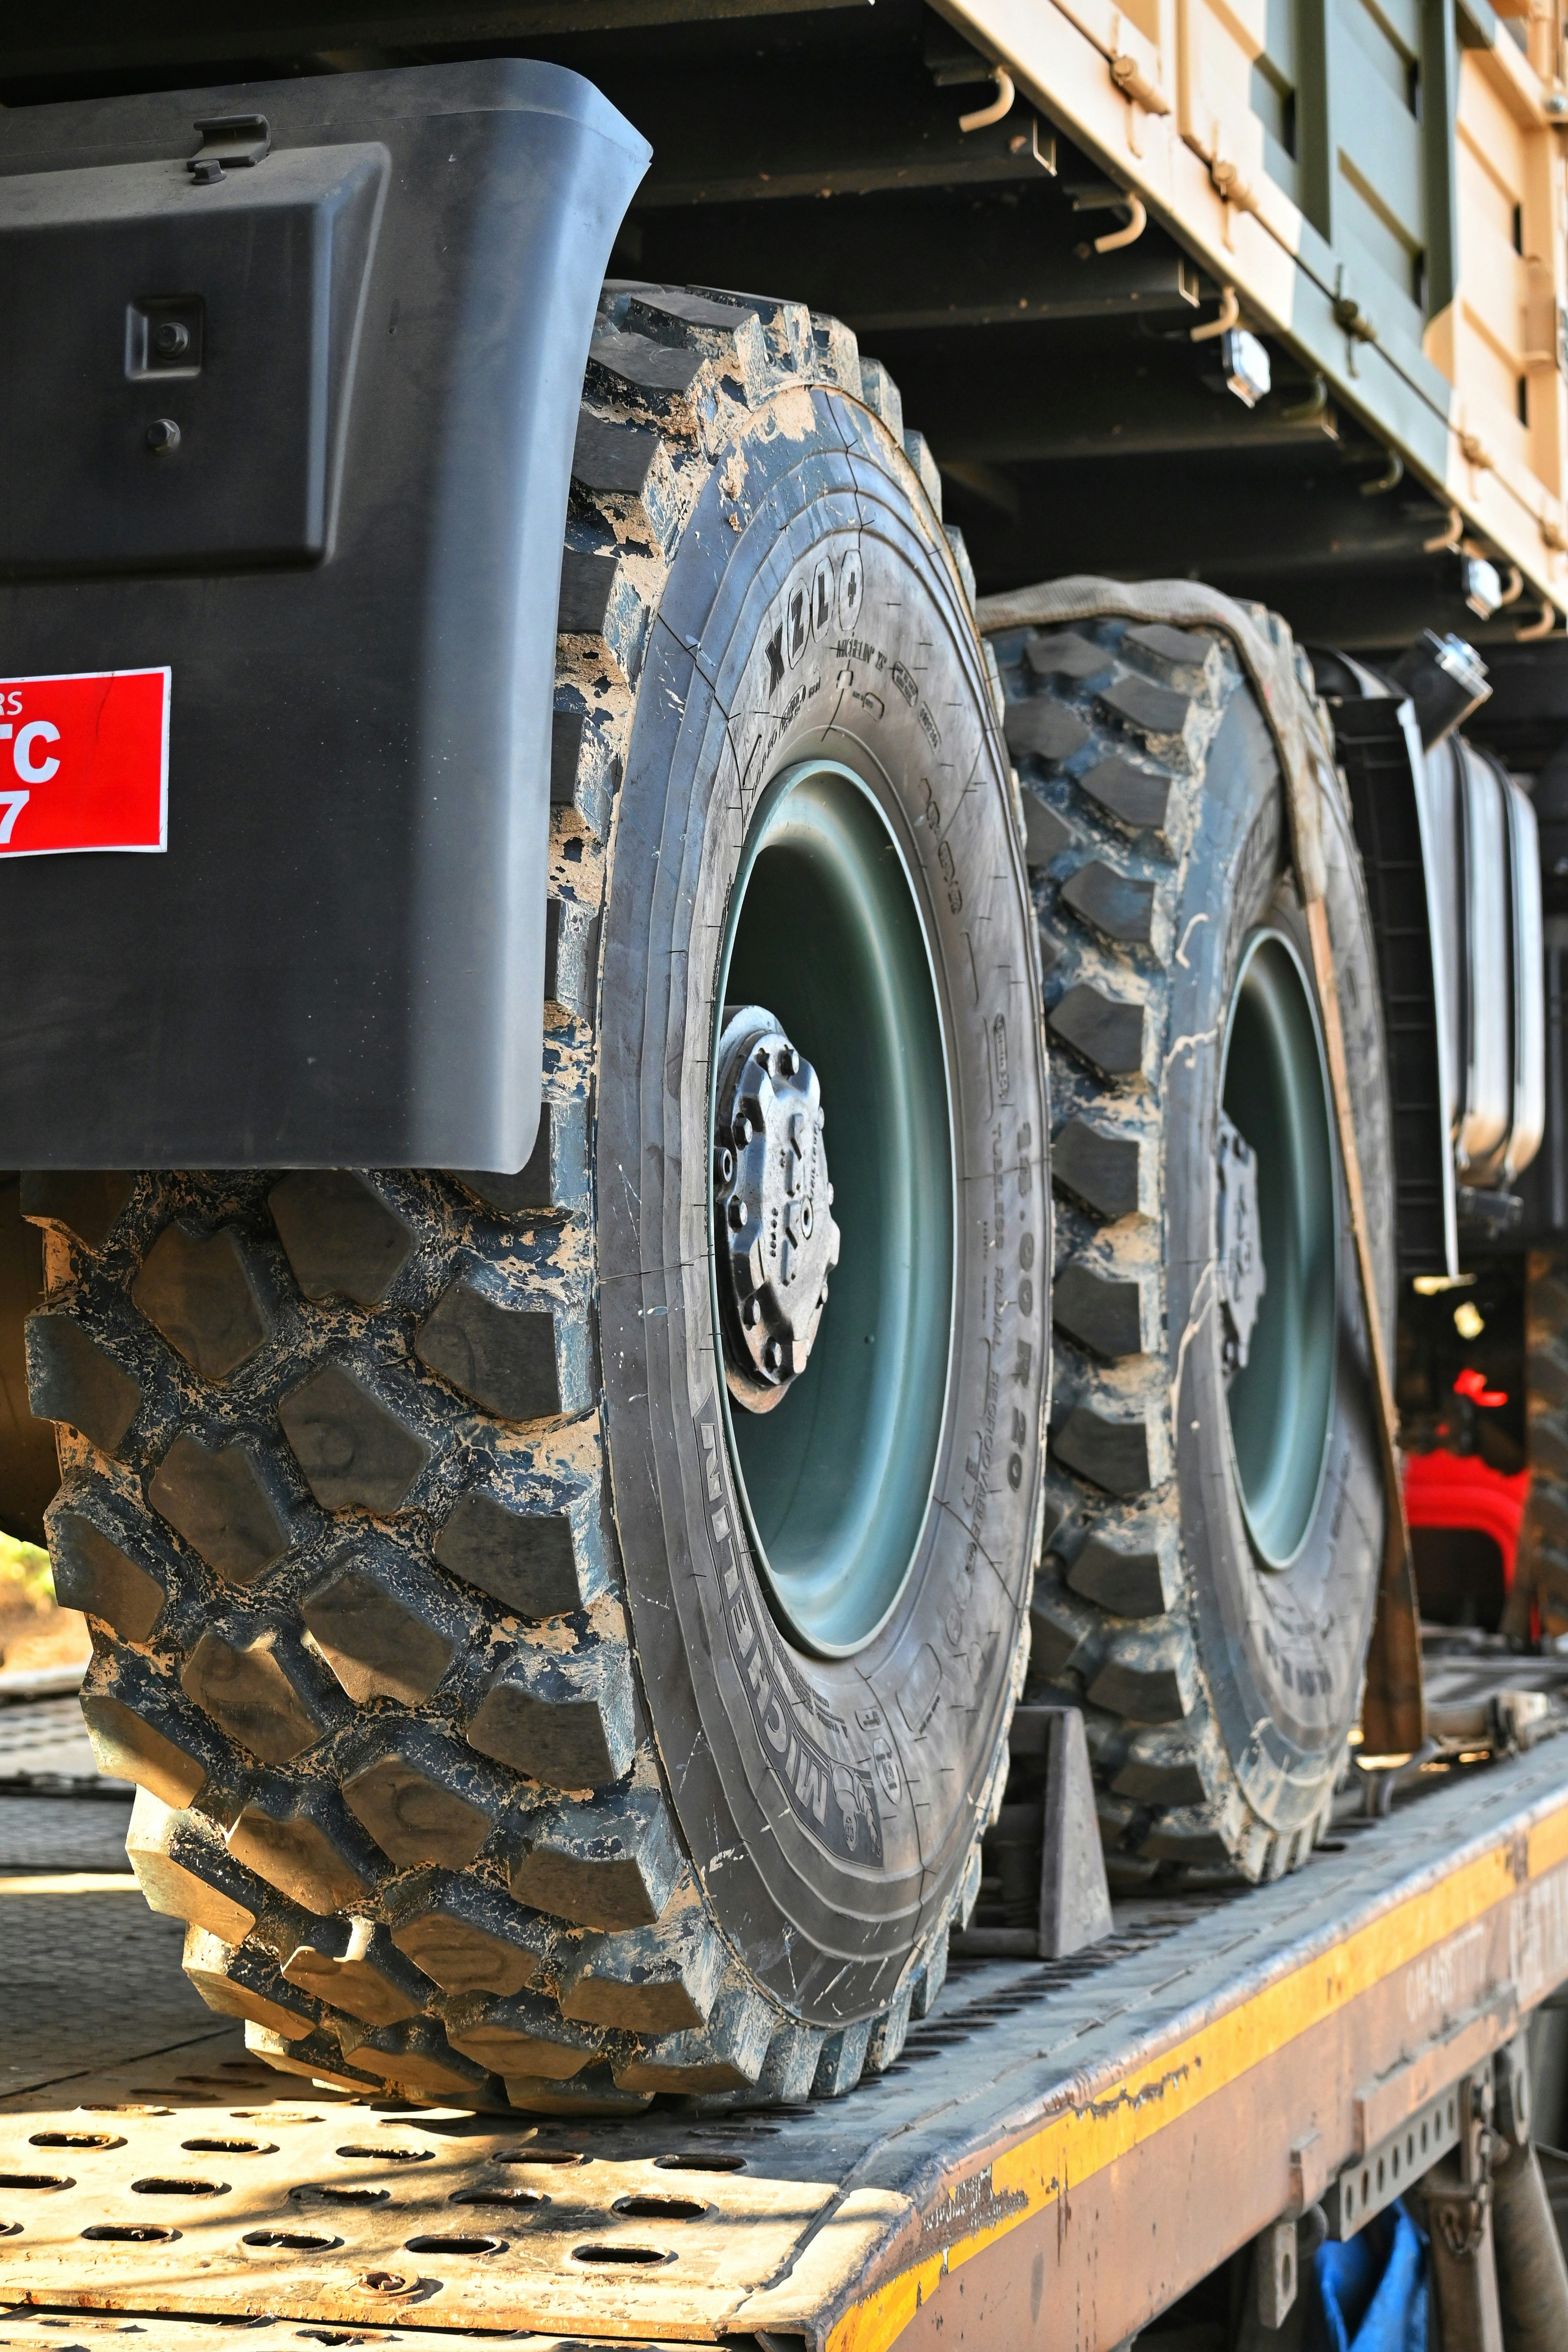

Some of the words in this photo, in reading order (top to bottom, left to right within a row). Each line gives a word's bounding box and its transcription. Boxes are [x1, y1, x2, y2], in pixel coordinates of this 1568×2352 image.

[992, 1122, 1005, 1250] TUBELESS
[991, 1266, 1004, 1351] RADIAL
[700, 1423, 829, 1826] MICHELIN
